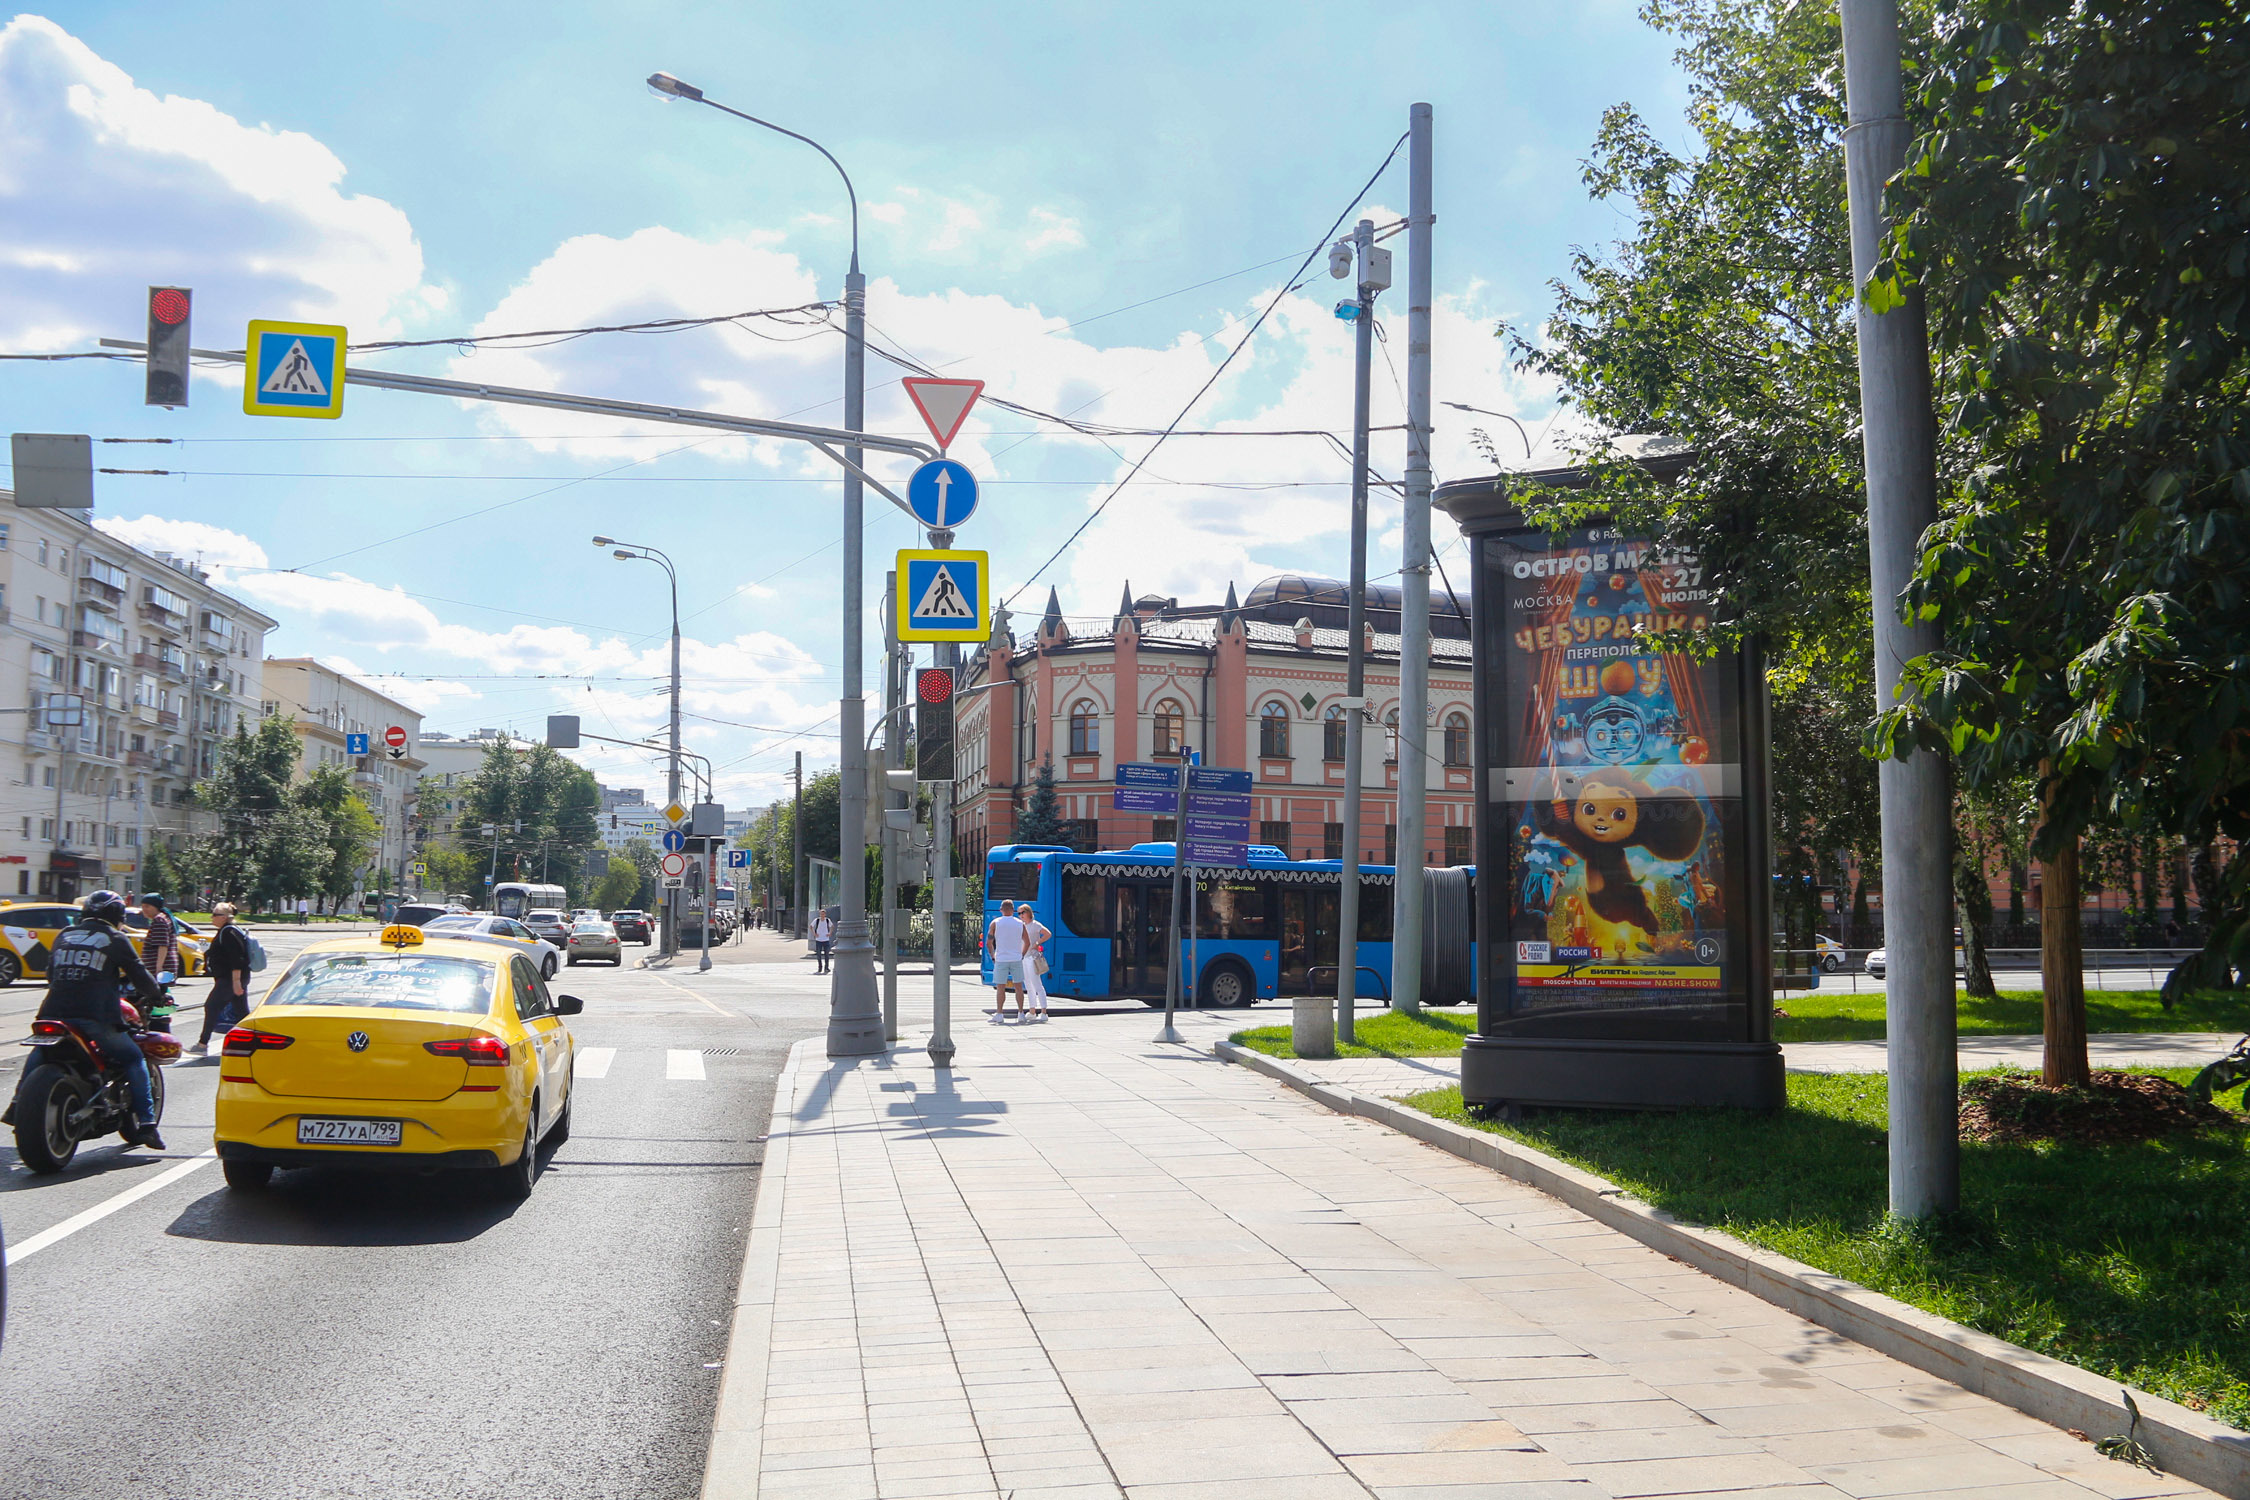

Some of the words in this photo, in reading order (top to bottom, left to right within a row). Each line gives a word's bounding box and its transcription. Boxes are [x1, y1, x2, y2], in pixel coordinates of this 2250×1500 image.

[1513, 554, 1609, 579] ОСТРОВ
[1674, 568, 1702, 588] 27
[1513, 595, 1574, 609] МОСКВА
[1661, 589, 1707, 603] ИЮЛЯ
[1558, 949, 1588, 957] РОССИЯ
[1701, 945, 1715, 957] 0+
[1543, 978, 1596, 986] moscow-hall.ru
[1655, 979, 1718, 987] NASHE.SHOW
[372, 1123, 396, 1135] 799
